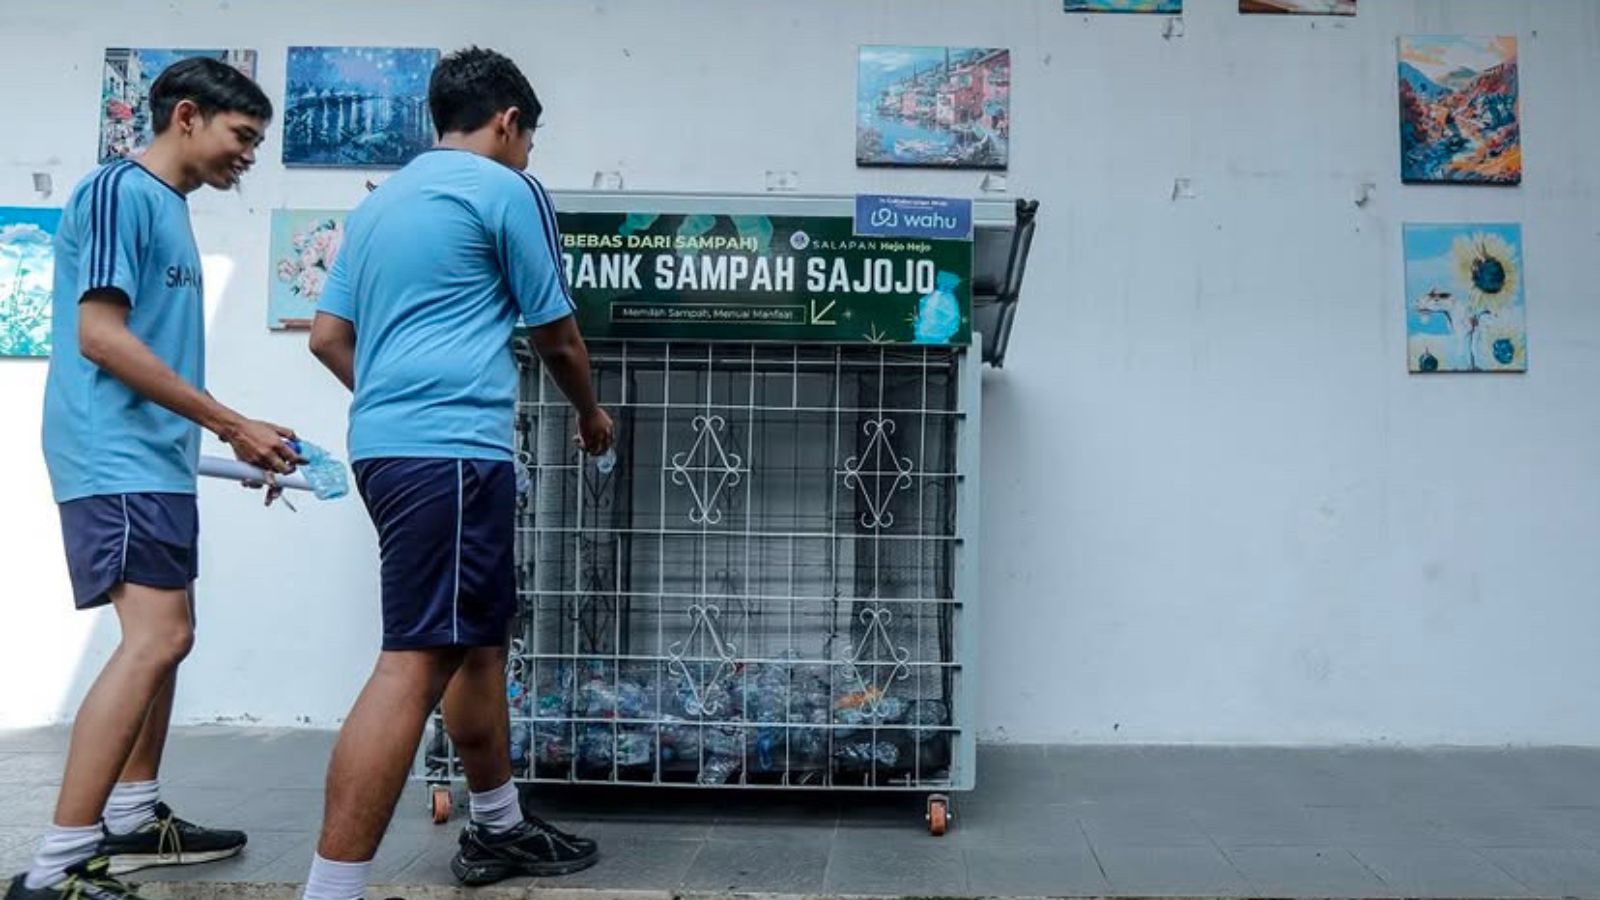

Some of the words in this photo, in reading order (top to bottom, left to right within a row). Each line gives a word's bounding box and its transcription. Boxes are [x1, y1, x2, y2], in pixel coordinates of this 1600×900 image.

[903, 212, 957, 230] wahu
[627, 234, 670, 249] DARI
[674, 235, 758, 252] SAMPAH)
[812, 240, 876, 250] SALAPAN
[654, 253, 795, 292] SAMPAH
[806, 256, 935, 295] SAJOJO
